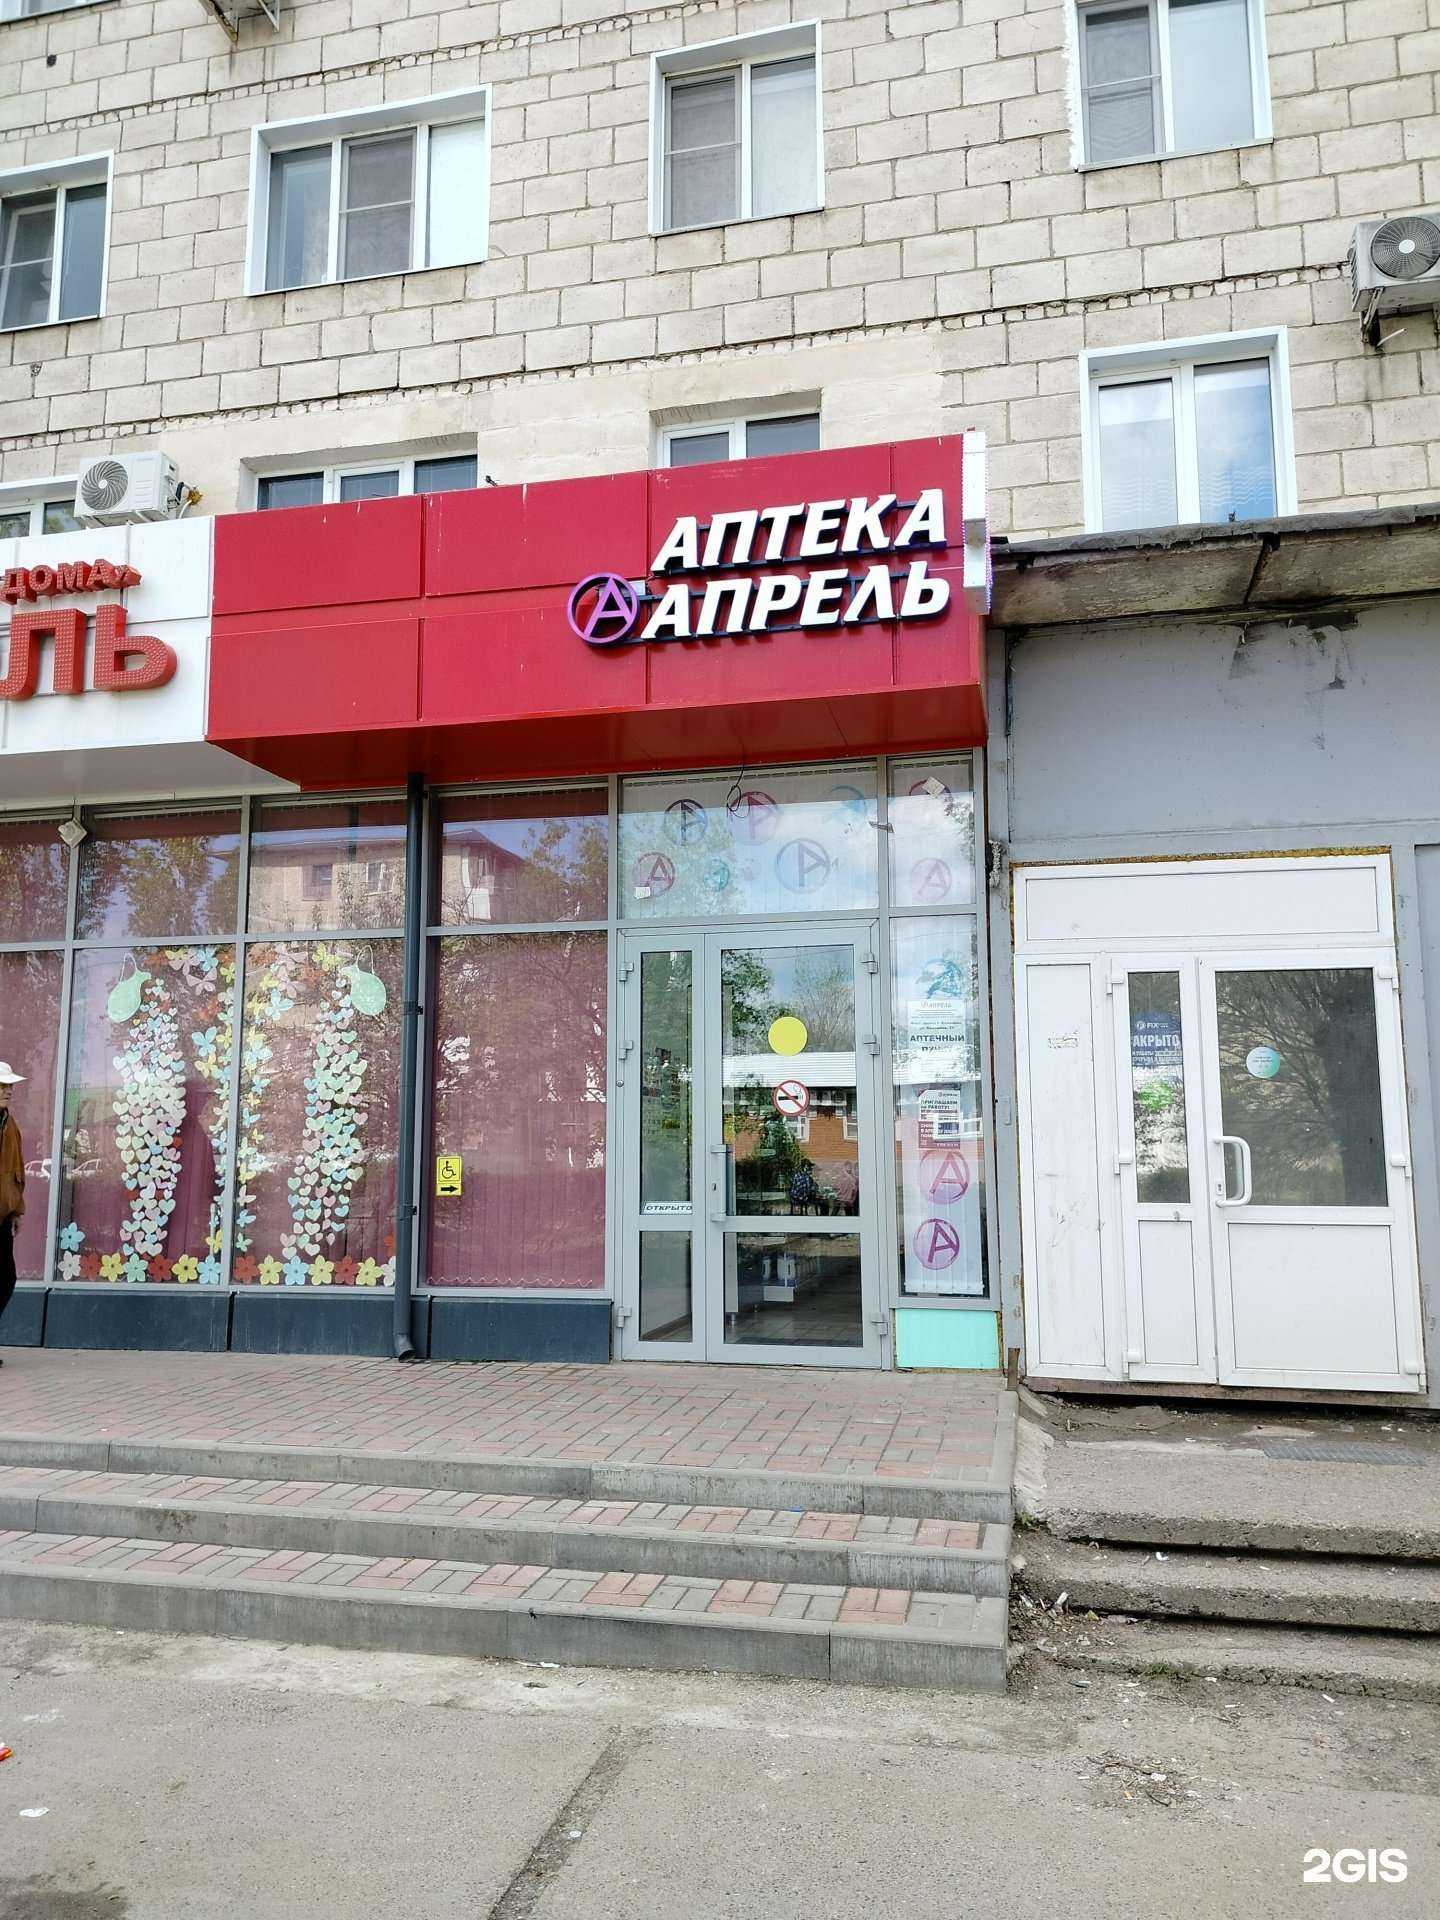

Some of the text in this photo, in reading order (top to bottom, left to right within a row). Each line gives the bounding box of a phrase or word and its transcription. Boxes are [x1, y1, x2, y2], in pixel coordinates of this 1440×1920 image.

[650, 488, 947, 573] АПТЕКА
[640, 560, 950, 639] АПРЕЛЬ
[910, 1034, 965, 1042] АПТЕЧНЫЙ
[1132, 1034, 1180, 1047] АКРЫТО
